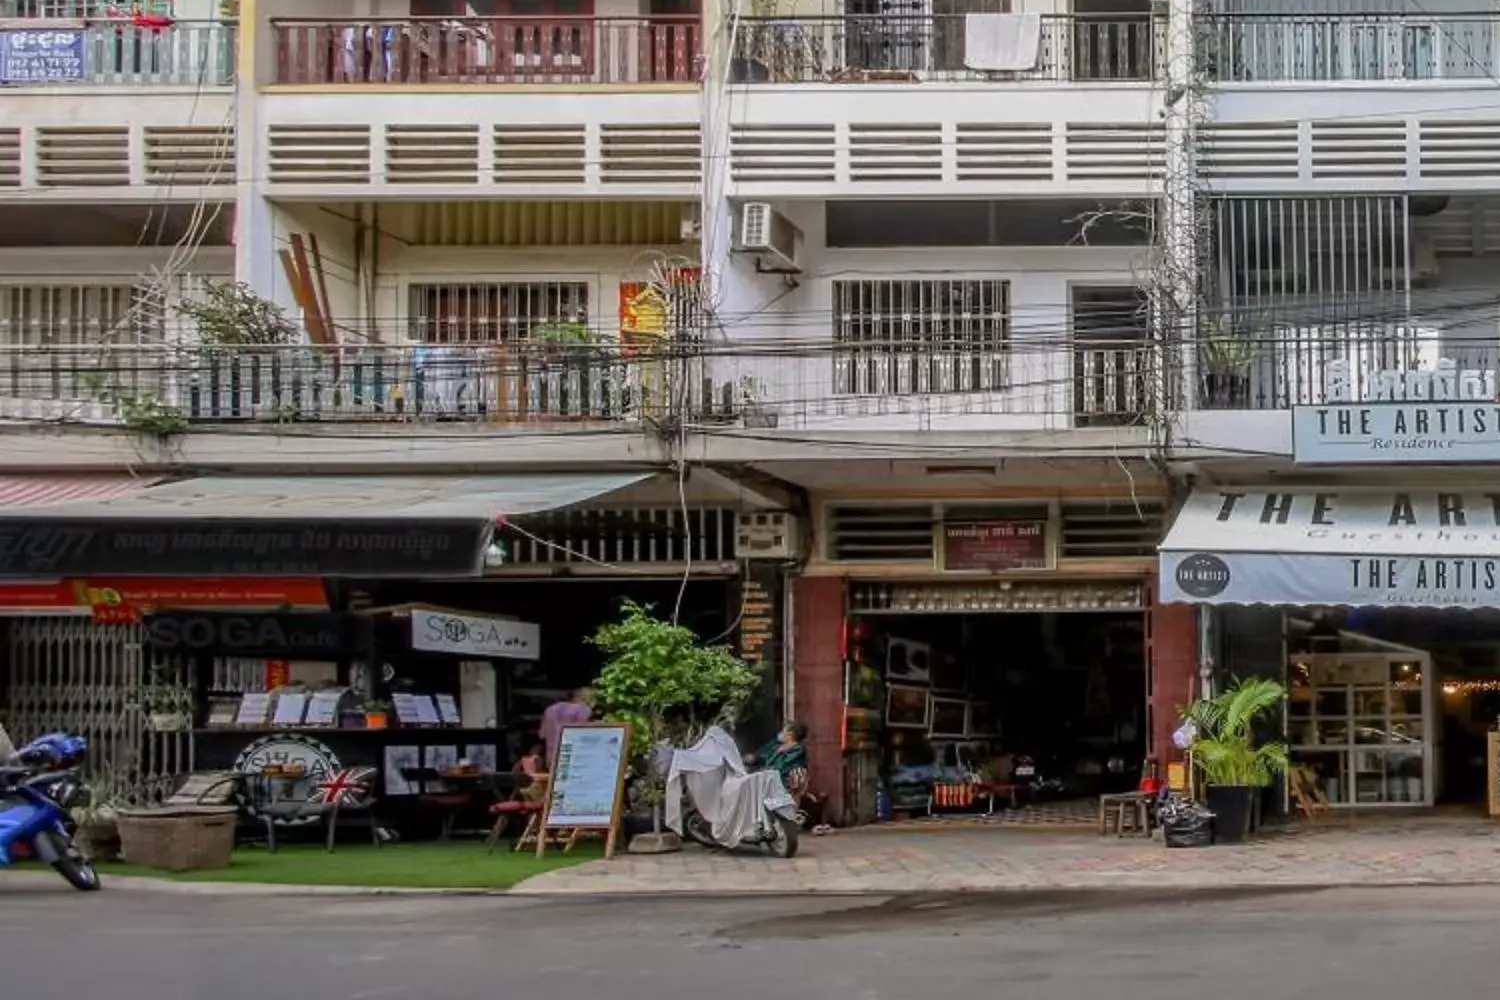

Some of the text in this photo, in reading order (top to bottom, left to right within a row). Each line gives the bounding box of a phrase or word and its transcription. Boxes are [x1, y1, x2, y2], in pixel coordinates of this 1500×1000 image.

[1317, 409, 1373, 435] THE
[1371, 436, 1457, 450] Residence
[1216, 492, 1339, 525] THE
[1351, 559, 1397, 588] THE
[148, 616, 289, 648] SOGA
